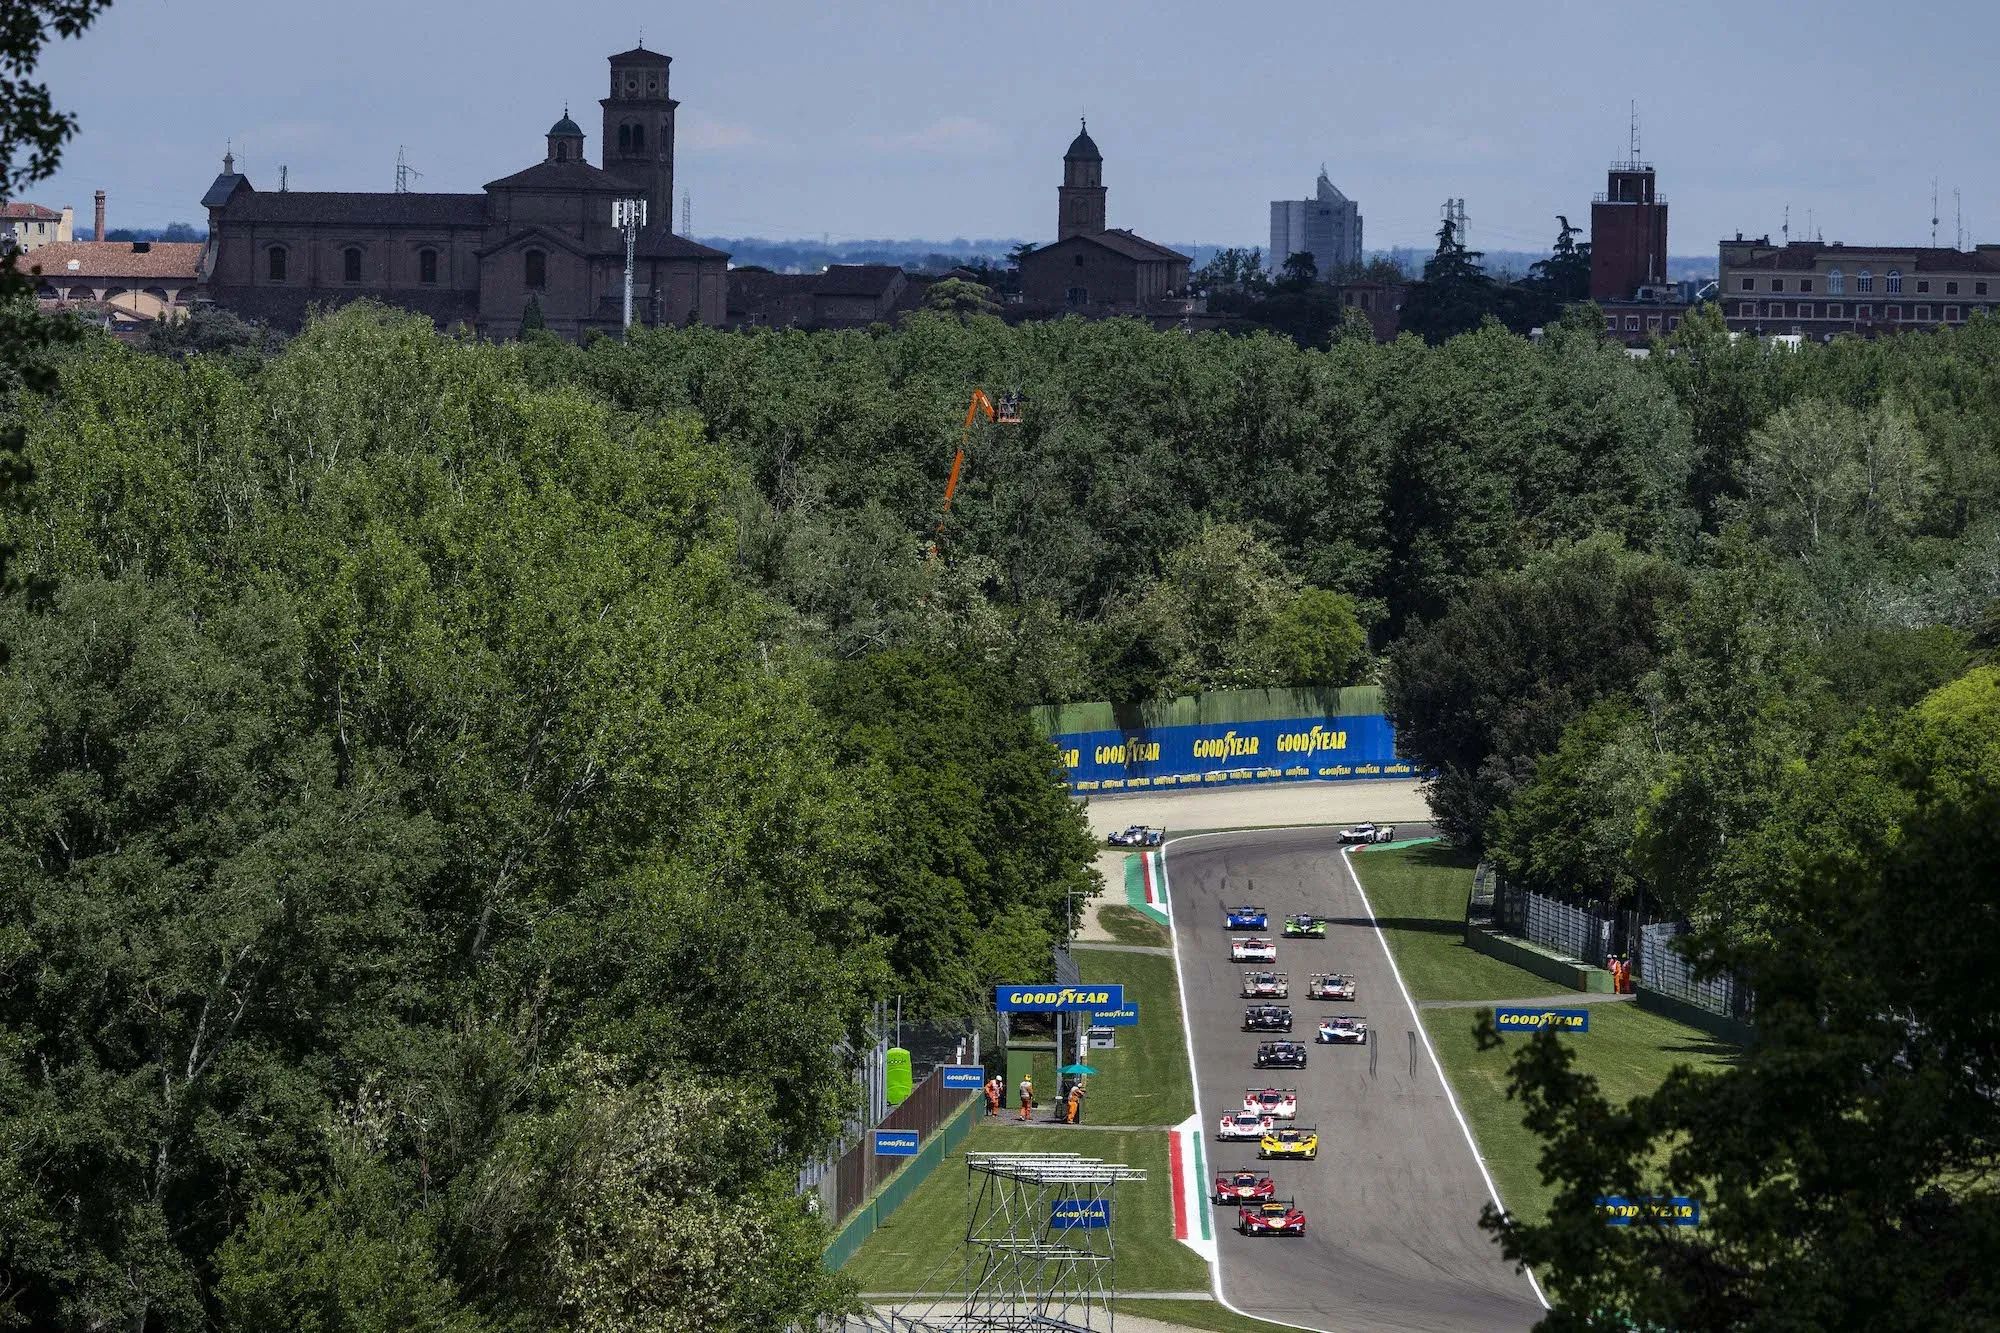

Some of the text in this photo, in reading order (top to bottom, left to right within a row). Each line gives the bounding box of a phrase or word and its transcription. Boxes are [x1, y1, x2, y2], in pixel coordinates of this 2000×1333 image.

[1095, 740, 1160, 766] GOODYEAR
[1193, 734, 1259, 762] GOODYEAR
[1277, 729, 1347, 755] GOODYEAR
[1010, 991, 1109, 1005] GOODYEAR
[1095, 1010, 1134, 1018] GOODYEAR
[1499, 1013, 1584, 1026] GOODYEAR
